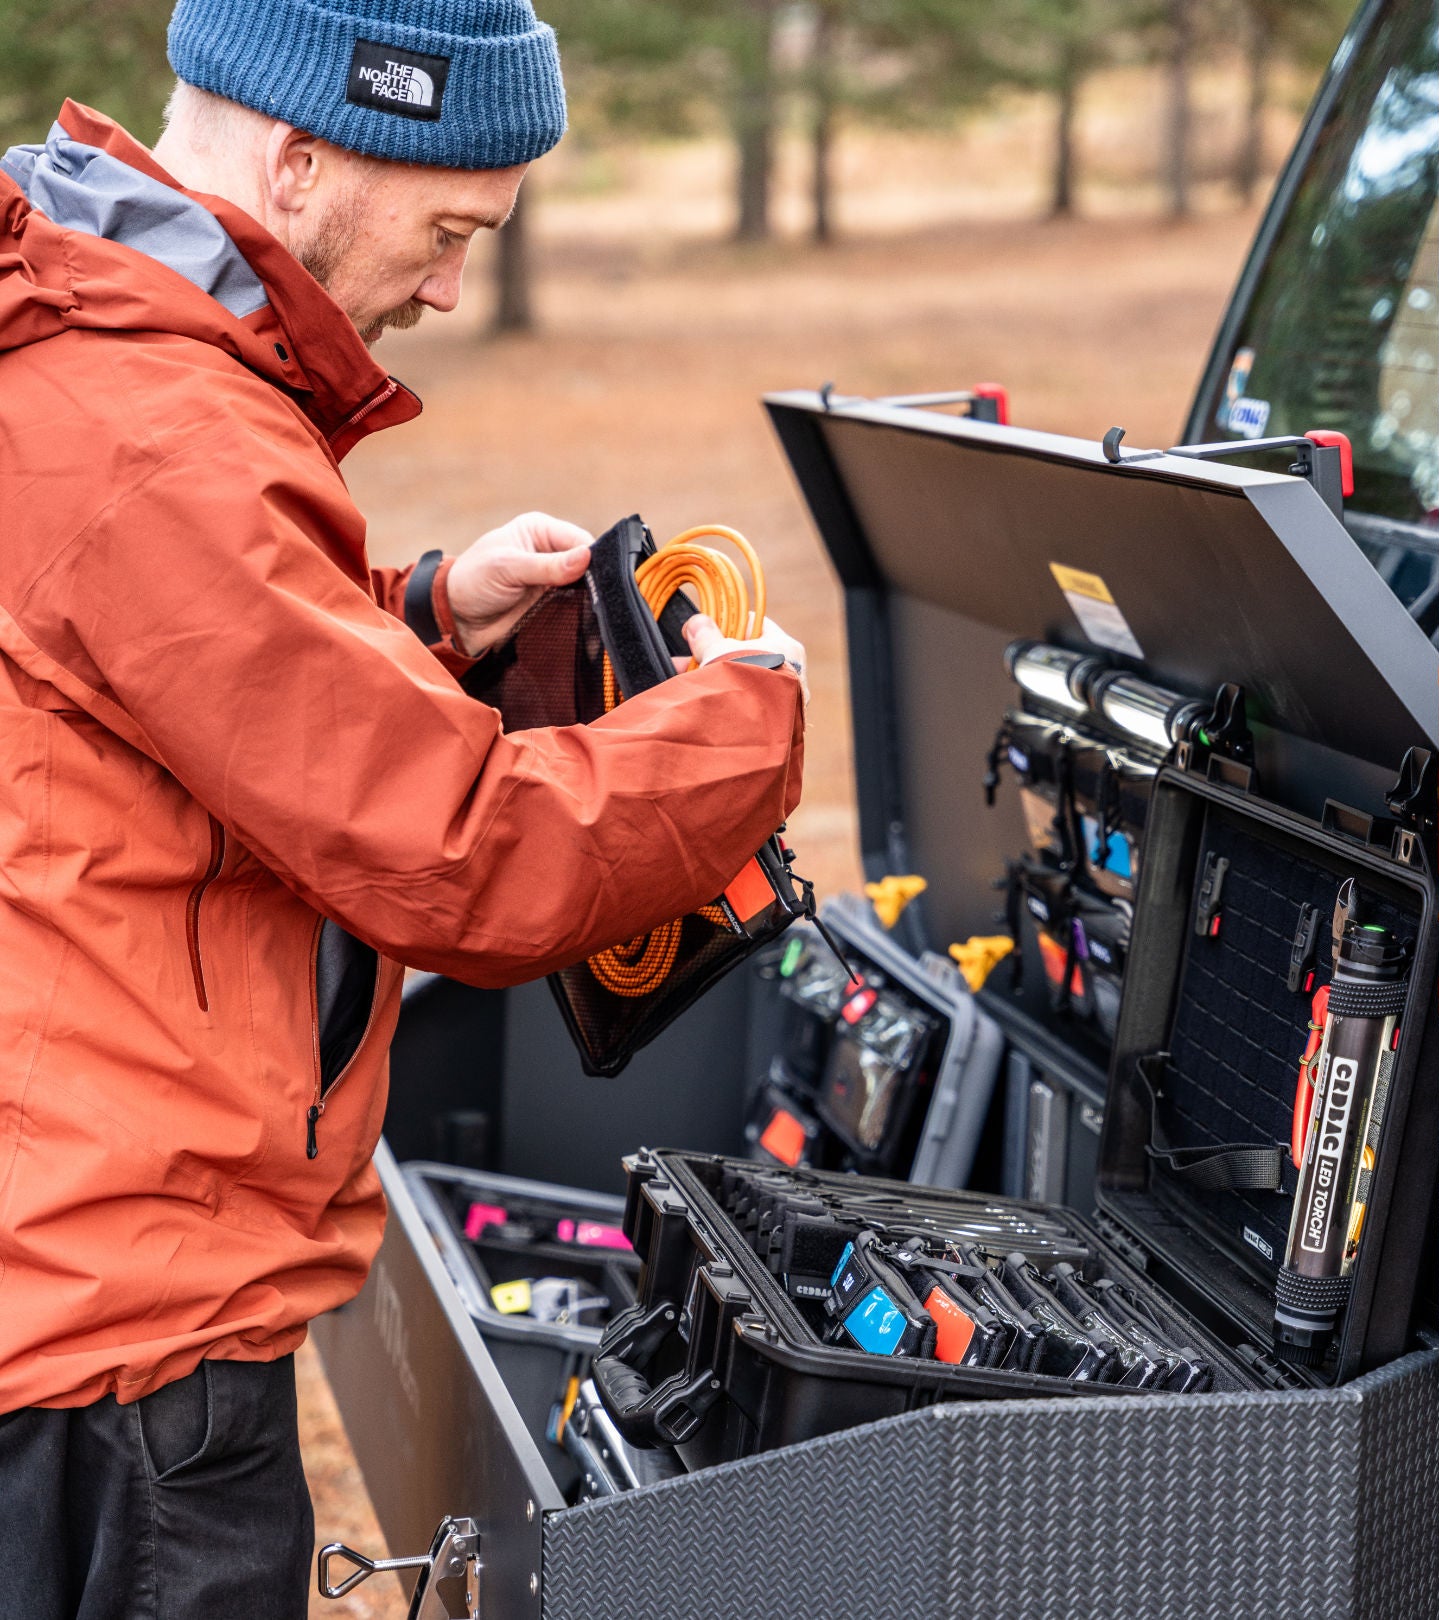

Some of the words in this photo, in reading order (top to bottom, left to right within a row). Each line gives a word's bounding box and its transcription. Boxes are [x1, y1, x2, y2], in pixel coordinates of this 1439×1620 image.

[358, 66, 411, 89] NORTH
[385, 60, 414, 78] THE
[371, 82, 408, 102] FACE
[1322, 1063, 1353, 1151] CRDBAG
[1317, 1158, 1334, 1188] LED
